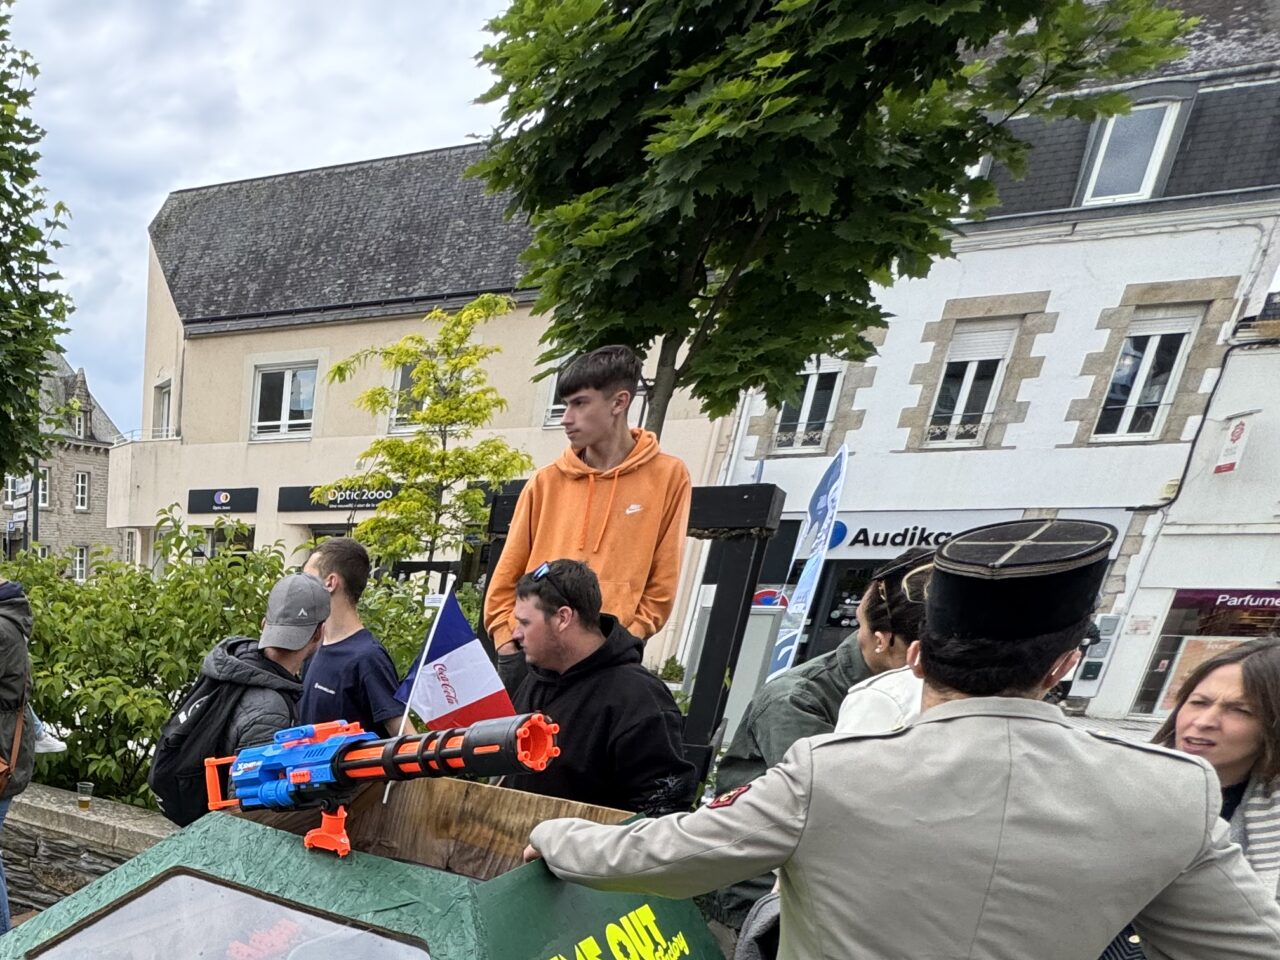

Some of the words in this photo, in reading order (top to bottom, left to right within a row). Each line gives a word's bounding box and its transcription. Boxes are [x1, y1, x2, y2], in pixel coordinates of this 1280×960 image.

[327, 489, 360, 504] Optic
[362, 489, 393, 500] 2000
[848, 526, 953, 547] Audika
